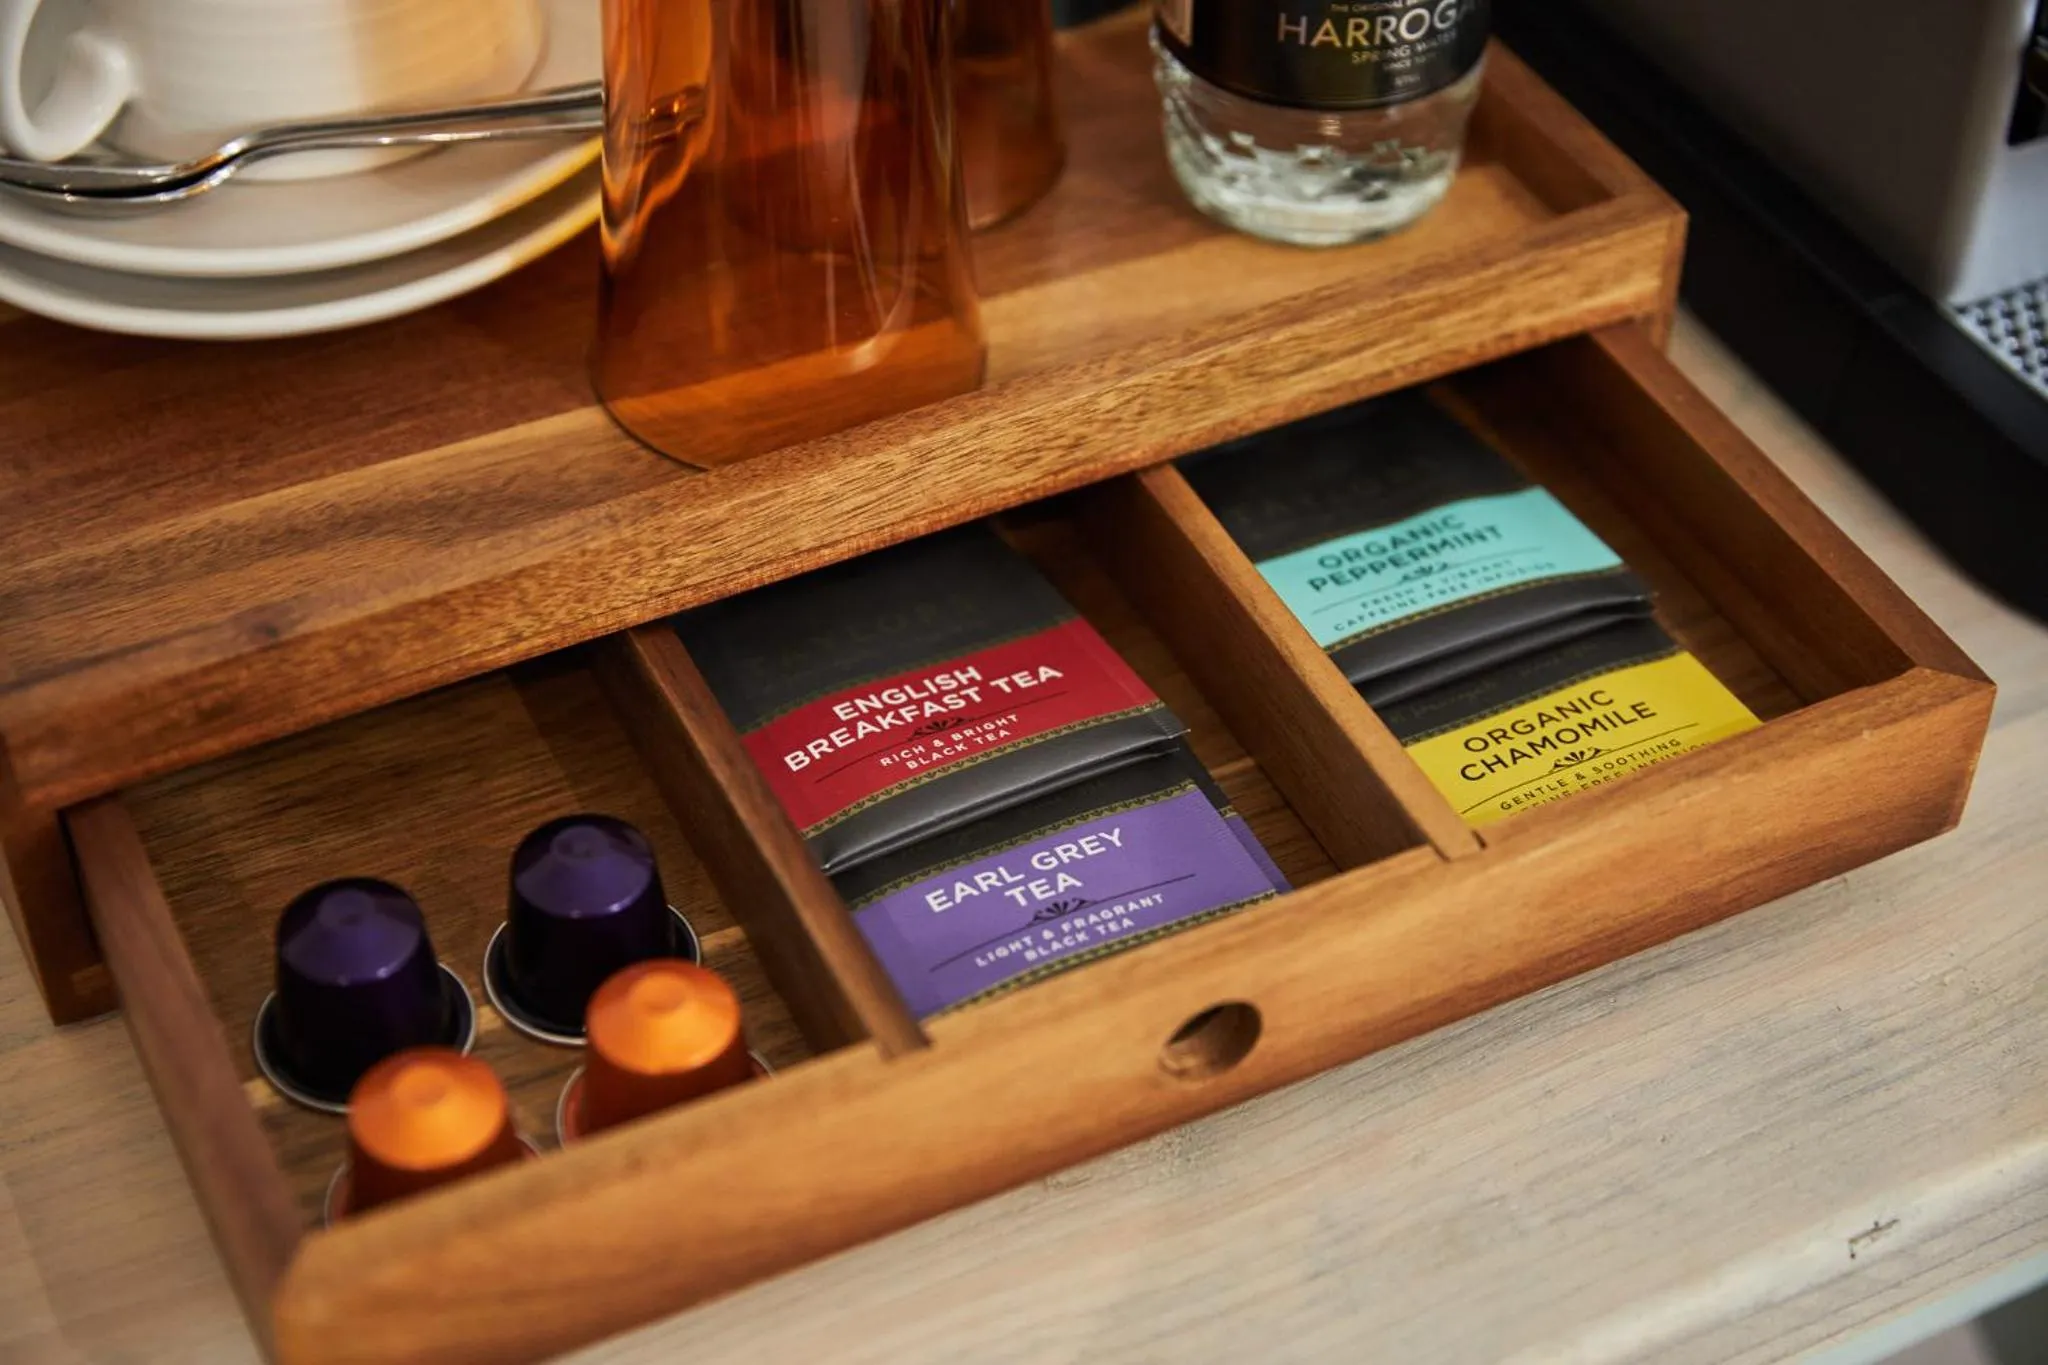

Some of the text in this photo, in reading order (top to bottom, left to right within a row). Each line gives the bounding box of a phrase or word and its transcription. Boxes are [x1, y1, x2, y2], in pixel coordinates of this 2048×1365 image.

[1351, 44, 1411, 65] SPRNG
[1307, 525, 1503, 593] PEPPERMINT
[1318, 513, 1465, 570] ORGANIC
[783, 664, 1065, 772] BREAKFAST TEA
[831, 665, 984, 721] ENGLISH
[1463, 689, 1615, 754] ORGANIC
[880, 713, 1019, 767] RICH & BRIGHT
[905, 729, 1011, 770] BLACK TEA
[1460, 702, 1657, 781] CHAMOMILE
[1500, 738, 1681, 811] GENTLE & SOOTHING
[925, 828, 1124, 913] EARL GREY
[1003, 872, 1084, 908] TEA
[974, 893, 1165, 968] LIGHT & FRAGRANT
[1024, 917, 1135, 962] BLACK TEA
